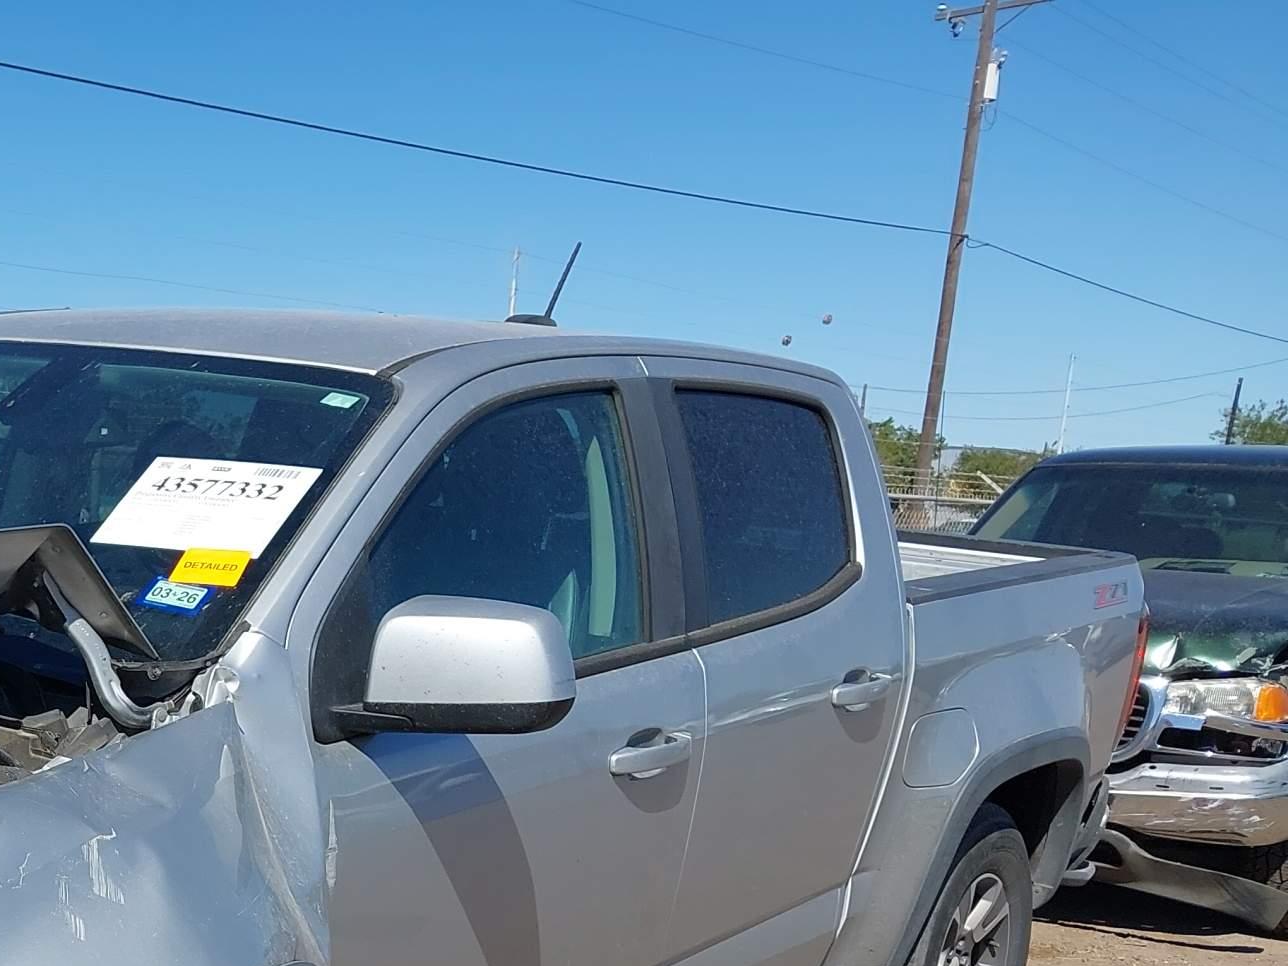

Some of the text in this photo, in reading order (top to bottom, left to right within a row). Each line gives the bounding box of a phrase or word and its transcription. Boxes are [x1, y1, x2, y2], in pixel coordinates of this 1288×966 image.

[152, 475, 285, 501] 43577332
[183, 561, 240, 573] DETAILED
[151, 585, 200, 605] 03 26
